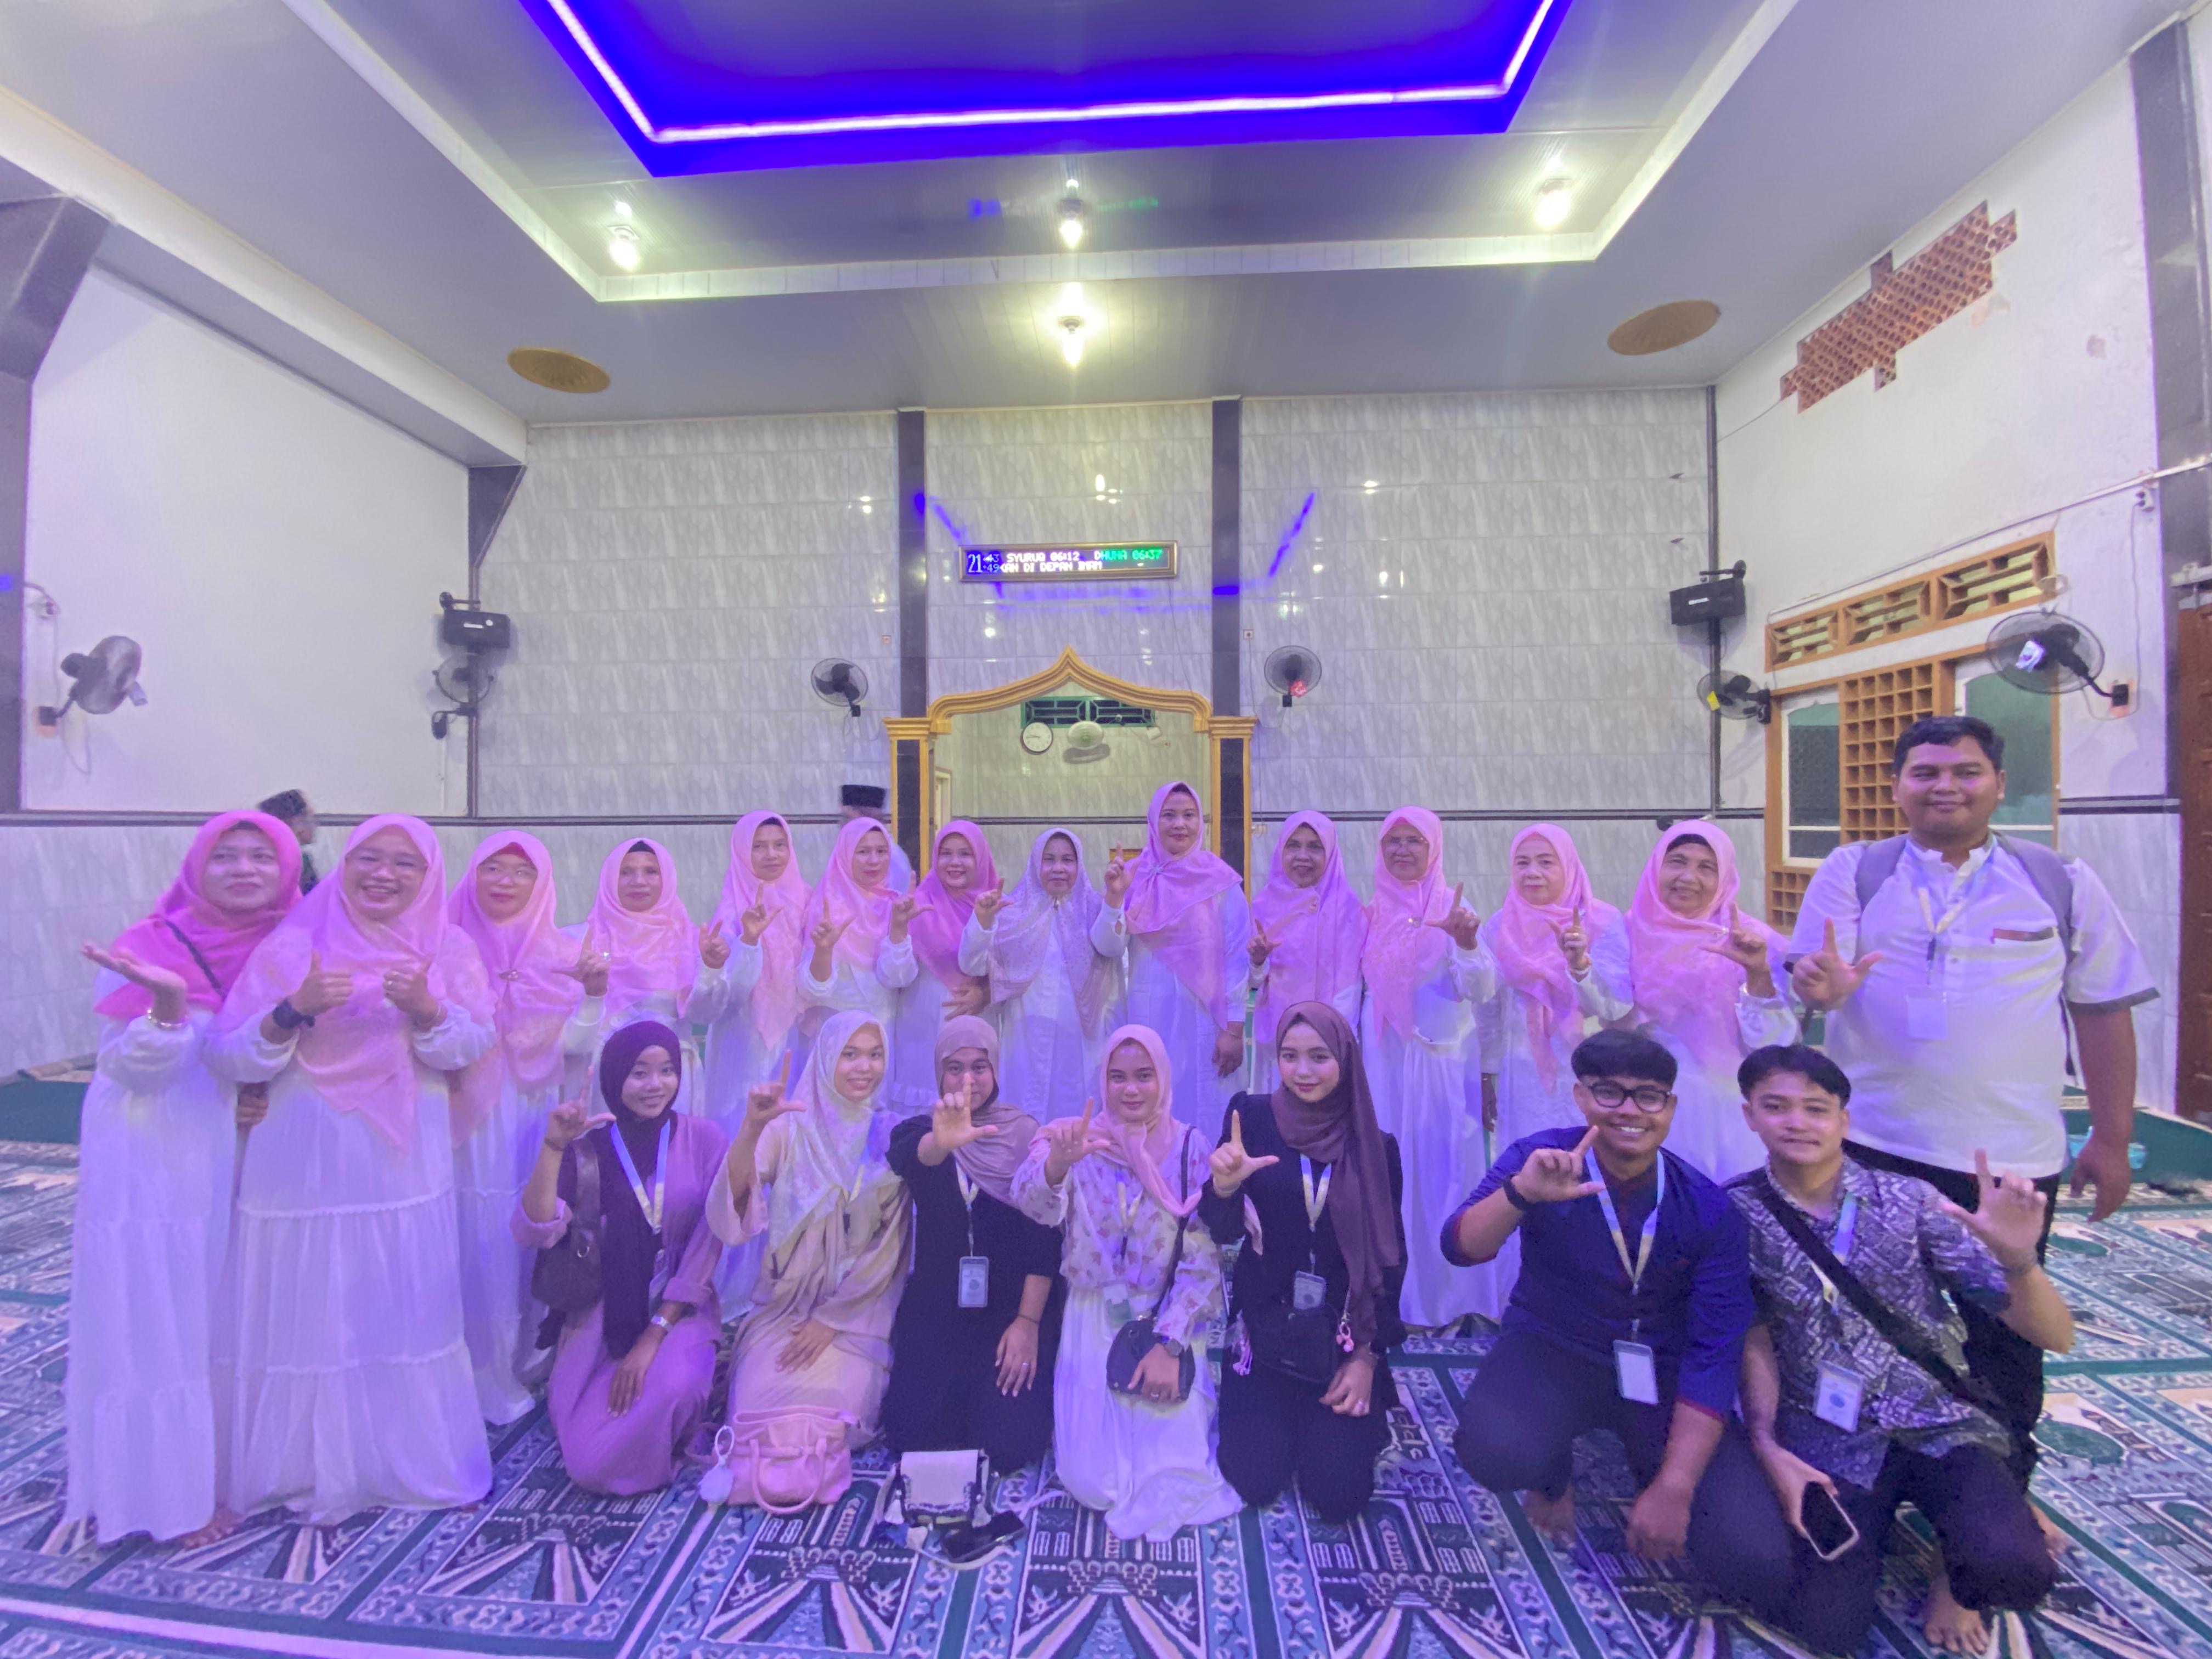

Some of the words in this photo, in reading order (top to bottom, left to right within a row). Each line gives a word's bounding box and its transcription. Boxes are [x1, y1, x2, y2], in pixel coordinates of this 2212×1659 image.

[1050, 551, 1080, 561] 06:12
[1132, 549, 1163, 560] 06:37
[1023, 562, 1035, 572] DI
[1040, 562, 1073, 572] DEPAN
